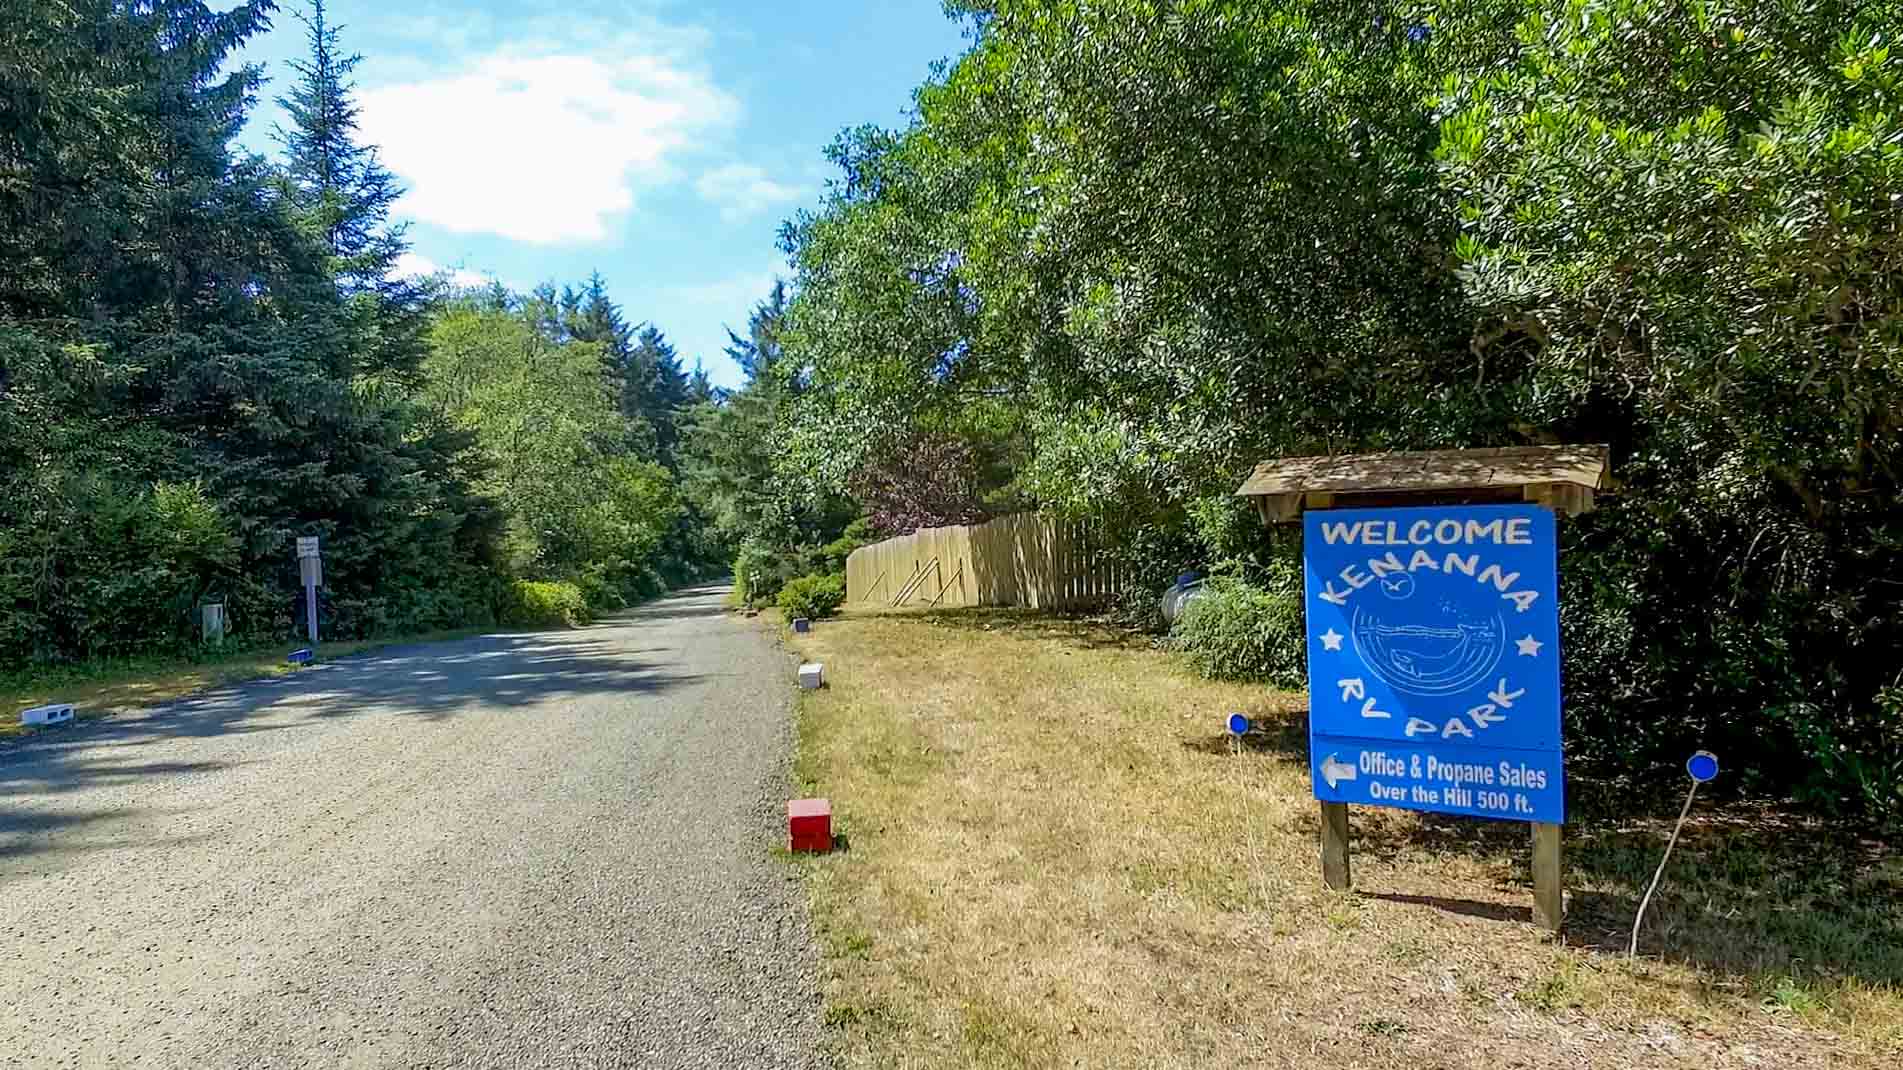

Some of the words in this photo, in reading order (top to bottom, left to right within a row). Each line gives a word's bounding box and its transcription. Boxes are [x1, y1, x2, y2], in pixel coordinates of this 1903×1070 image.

[1321, 518, 1533, 545] WELCOME
[1318, 550, 1540, 613] KENANNA
[1337, 677, 1392, 719] RV
[1405, 678, 1526, 738] PARK
[1359, 750, 1405, 777] Office
[1410, 754, 1423, 779] &
[1427, 755, 1494, 787] Propane
[1499, 761, 1547, 789] Sales
[1370, 782, 1408, 800] Over
[1412, 785, 1439, 804] the
[1444, 788, 1472, 807] Hill
[1478, 791, 1509, 811] 500
[1514, 794, 1534, 814] ft.
